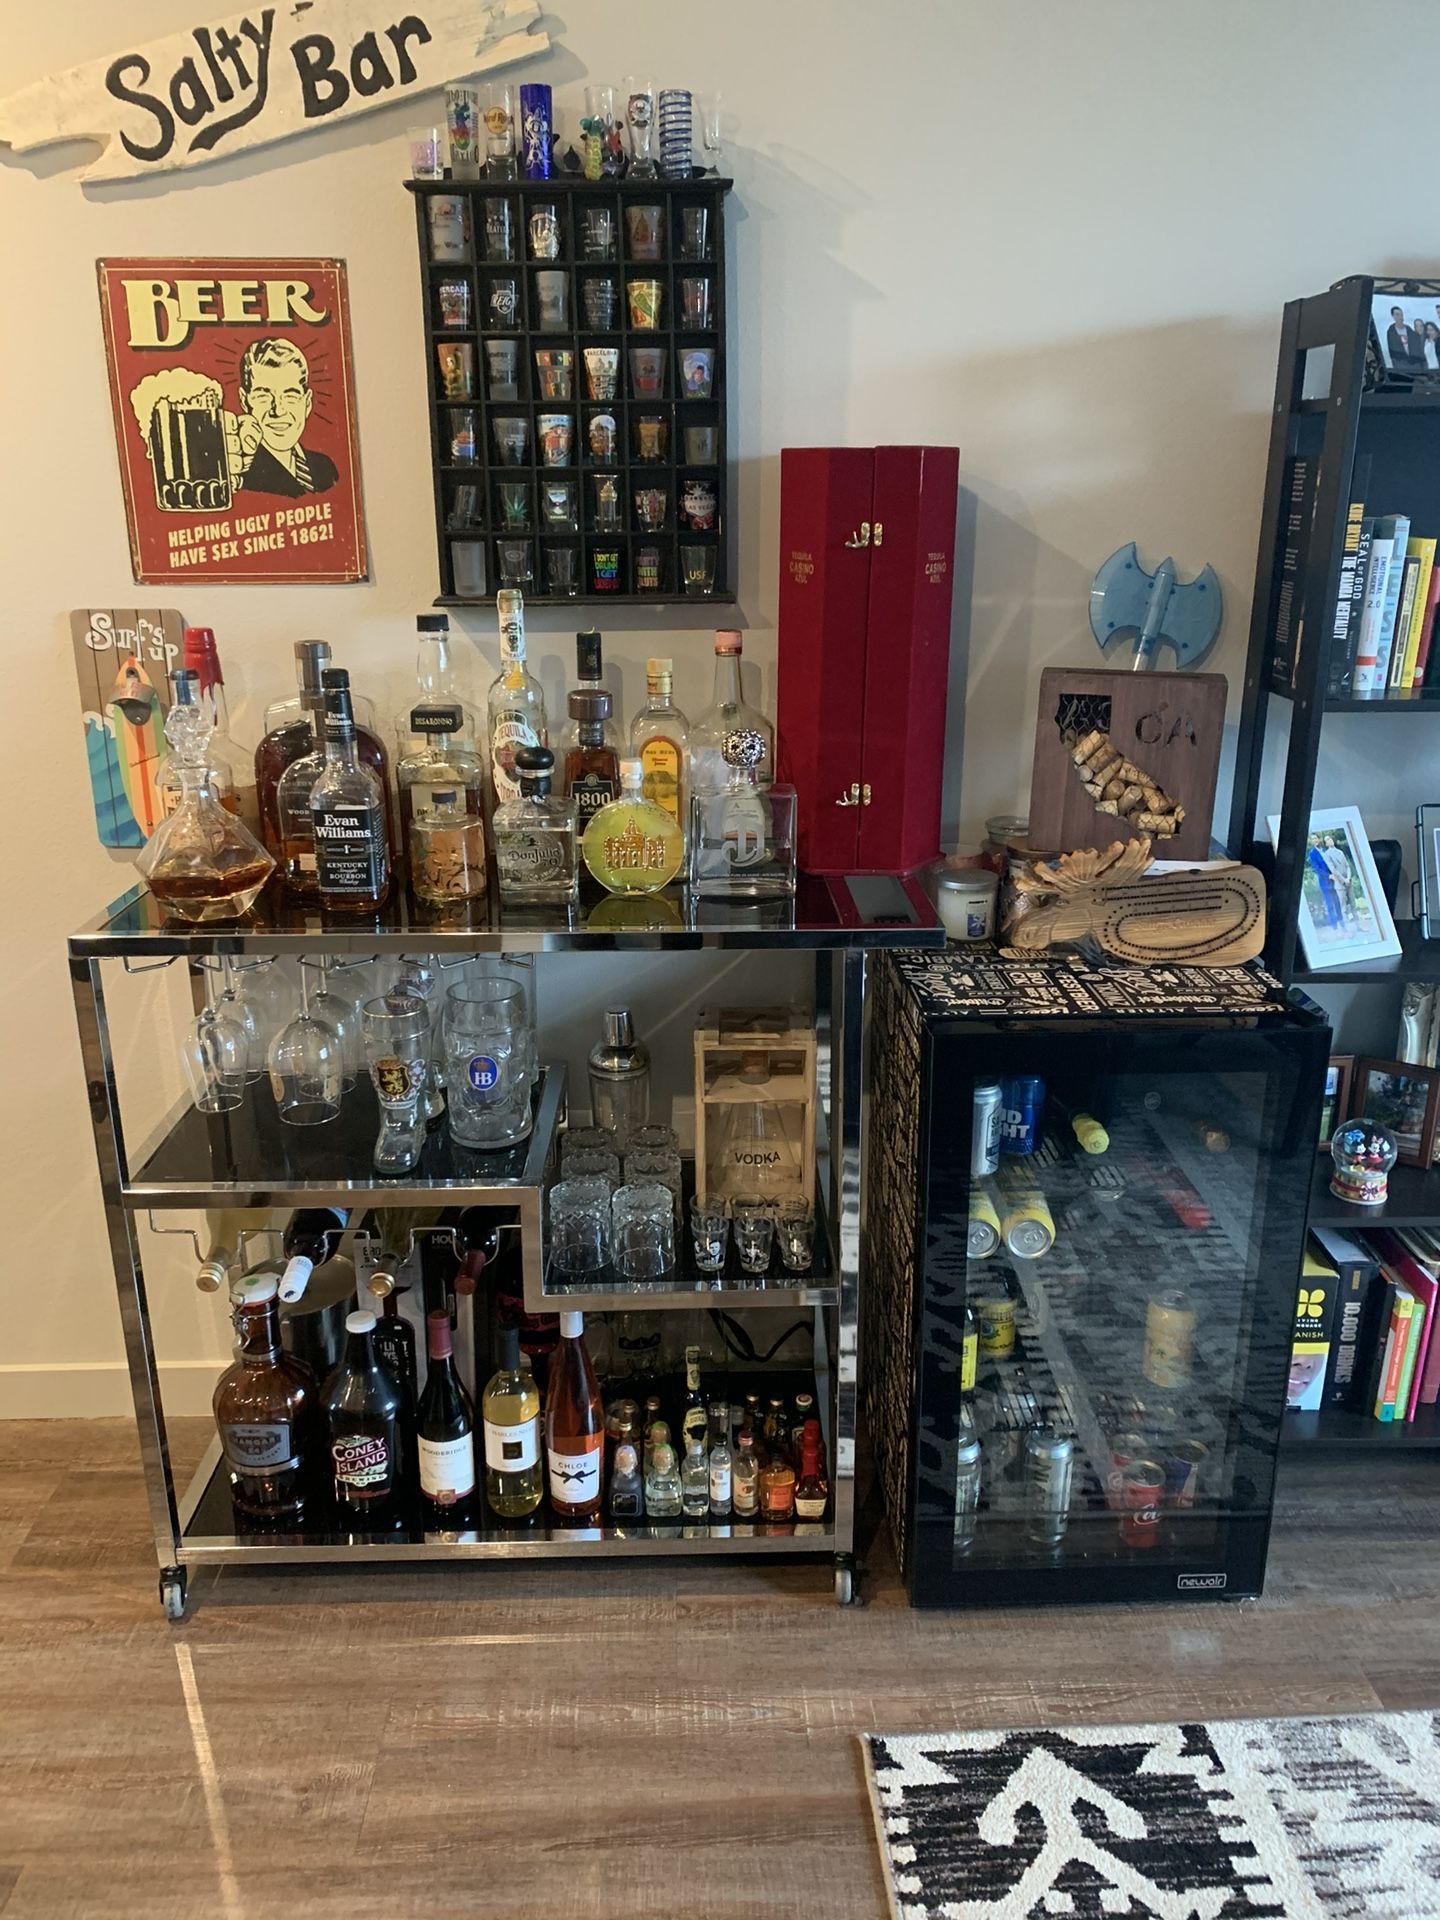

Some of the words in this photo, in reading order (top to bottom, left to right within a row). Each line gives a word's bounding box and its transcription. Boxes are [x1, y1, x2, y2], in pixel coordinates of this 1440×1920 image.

[105, 7, 275, 162] Salty
[291, 15, 431, 118] Bar
[120, 279, 329, 350] BEER
[168, 518, 230, 548] HELPING
[236, 512, 271, 537] UGLY
[275, 502, 333, 528] PEOPLE
[169, 544, 208, 569] HAVE
[243, 531, 286, 556] SINCE
[290, 524, 334, 547] 1862!
[1356, 532, 1370, 565] SEAL
[789, 561, 815, 575] CASINO
[925, 562, 947, 575] CASINO
[1375, 555, 1388, 595] EMOTIONAL
[1352, 577, 1364, 600] GOD
[1367, 600, 1381, 609] 2.0
[85, 613, 166, 662] Surf's
[149, 643, 179, 678] up
[574, 792, 611, 807] 1800
[324, 814, 360, 826] Evan
[316, 826, 373, 839] Williams
[910, 954, 989, 964] LAMBIC
[474, 1071, 492, 1085] HB
[734, 1151, 781, 1165] VODKA
[1340, 1302, 1362, 1342] 10,000
[1294, 1331, 1324, 1339] ANISH
[1334, 1344, 1356, 1383] DRINKS
[331, 1437, 385, 1462] CONEY
[335, 1451, 388, 1474] ISLAND
[557, 1461, 588, 1469] CHLOE
[1181, 1575, 1223, 1587] newair
